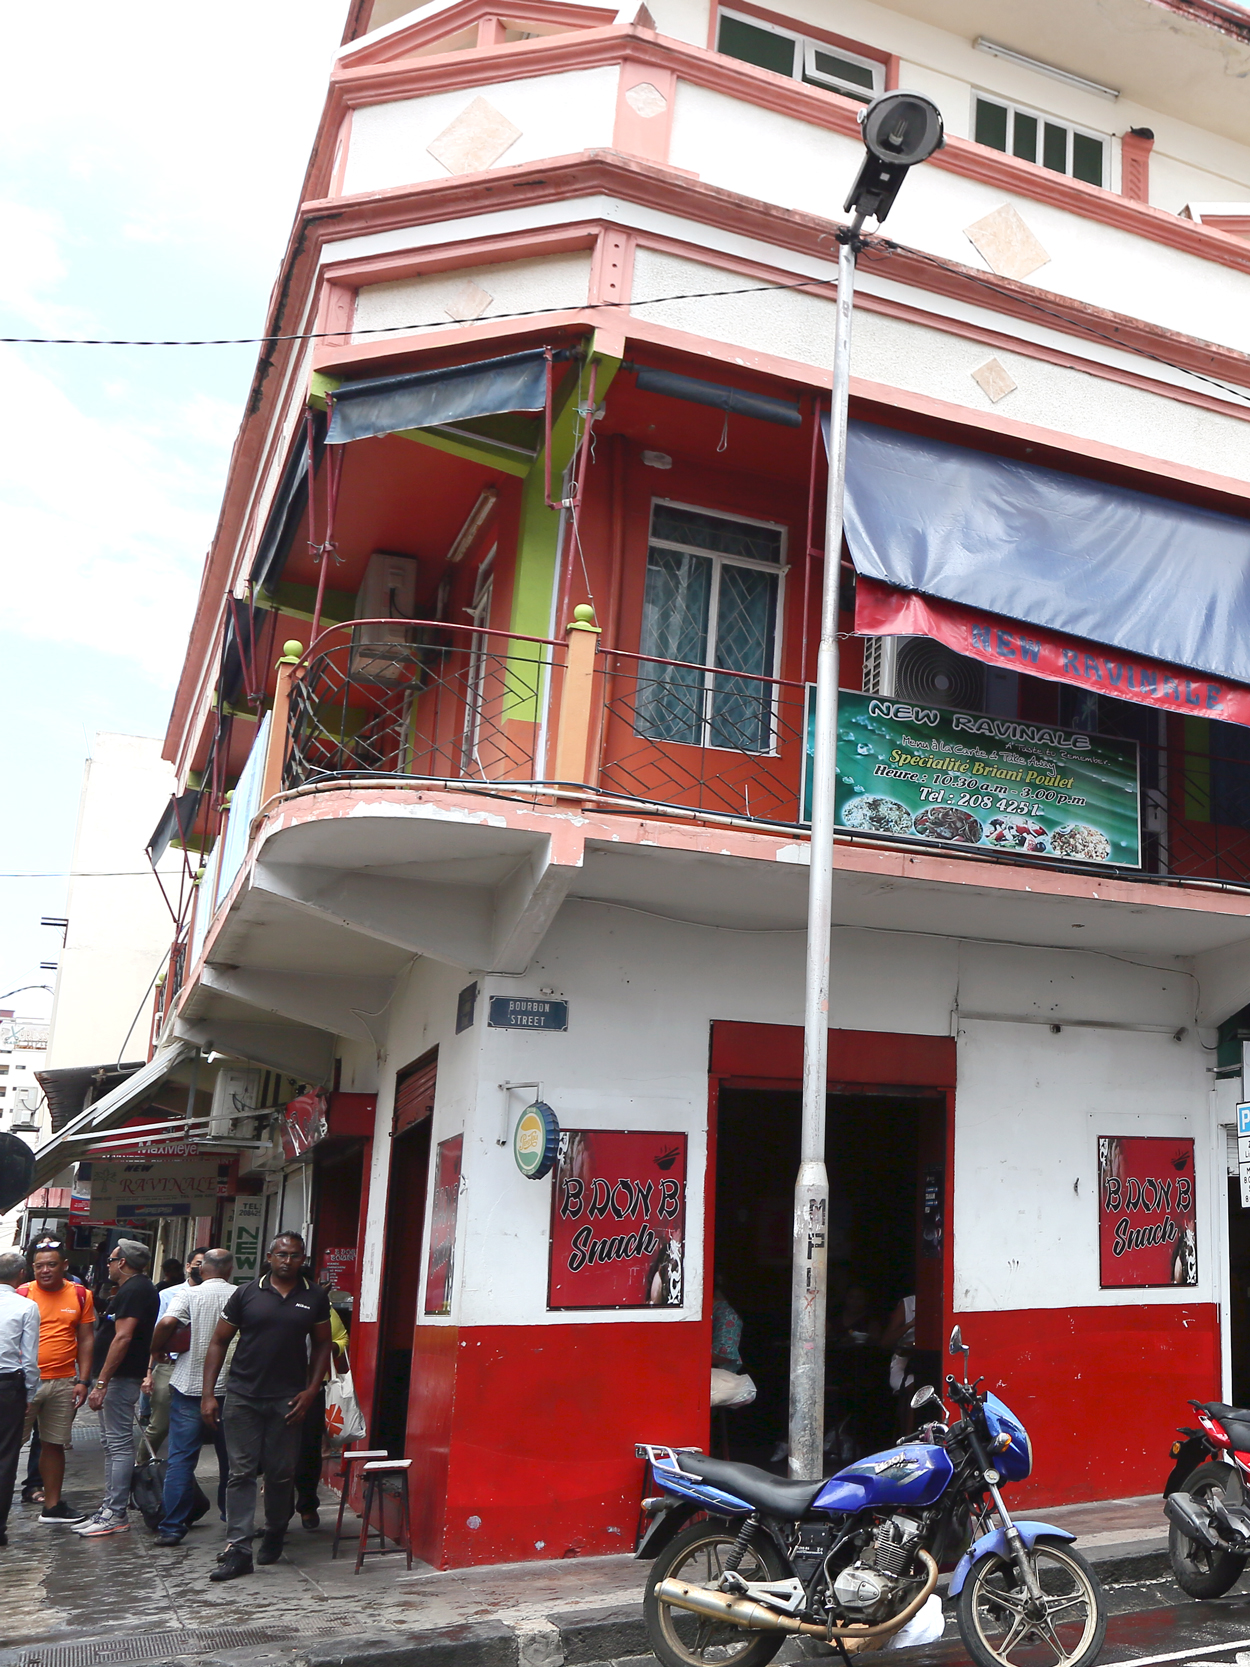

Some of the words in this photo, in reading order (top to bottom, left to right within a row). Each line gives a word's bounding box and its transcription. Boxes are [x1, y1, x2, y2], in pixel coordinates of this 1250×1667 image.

[970, 622, 1040, 662] NEW
[1063, 647, 1223, 710] RAVINALE
[869, 700, 940, 726] NEW
[953, 714, 1091, 750] RAVINALE
[889, 749, 971, 771] Specialité
[972, 761, 1023, 782] Briani
[1025, 770, 1075, 788] Poulet
[902, 735, 928, 750] Menu
[940, 741, 952, 753] la
[953, 745, 987, 758] Carte
[999, 752, 1027, 765] Take
[1028, 756, 1057, 777] Away
[874, 764, 918, 781] Heure
[932, 774, 978, 789] 10.30
[979, 783, 1008, 795] a.m
[1021, 787, 1055, 802] 3.00
[1056, 794, 1086, 806] p.m
[919, 787, 945, 803] Tel
[957, 792, 993, 808] 208
[995, 798, 1039, 816] 4251
[509, 1001, 550, 1012] BOURBON
[511, 1015, 545, 1026] STREET
[119, 1177, 218, 1195] RAVINALE
[124, 1165, 154, 1173] NEW
[560, 1178, 585, 1220] B
[657, 1178, 680, 1220] B
[1105, 1176, 1122, 1213] B
[1175, 1177, 1192, 1213] B
[567, 1222, 659, 1273] Snack
[1112, 1215, 1178, 1257] Snack
